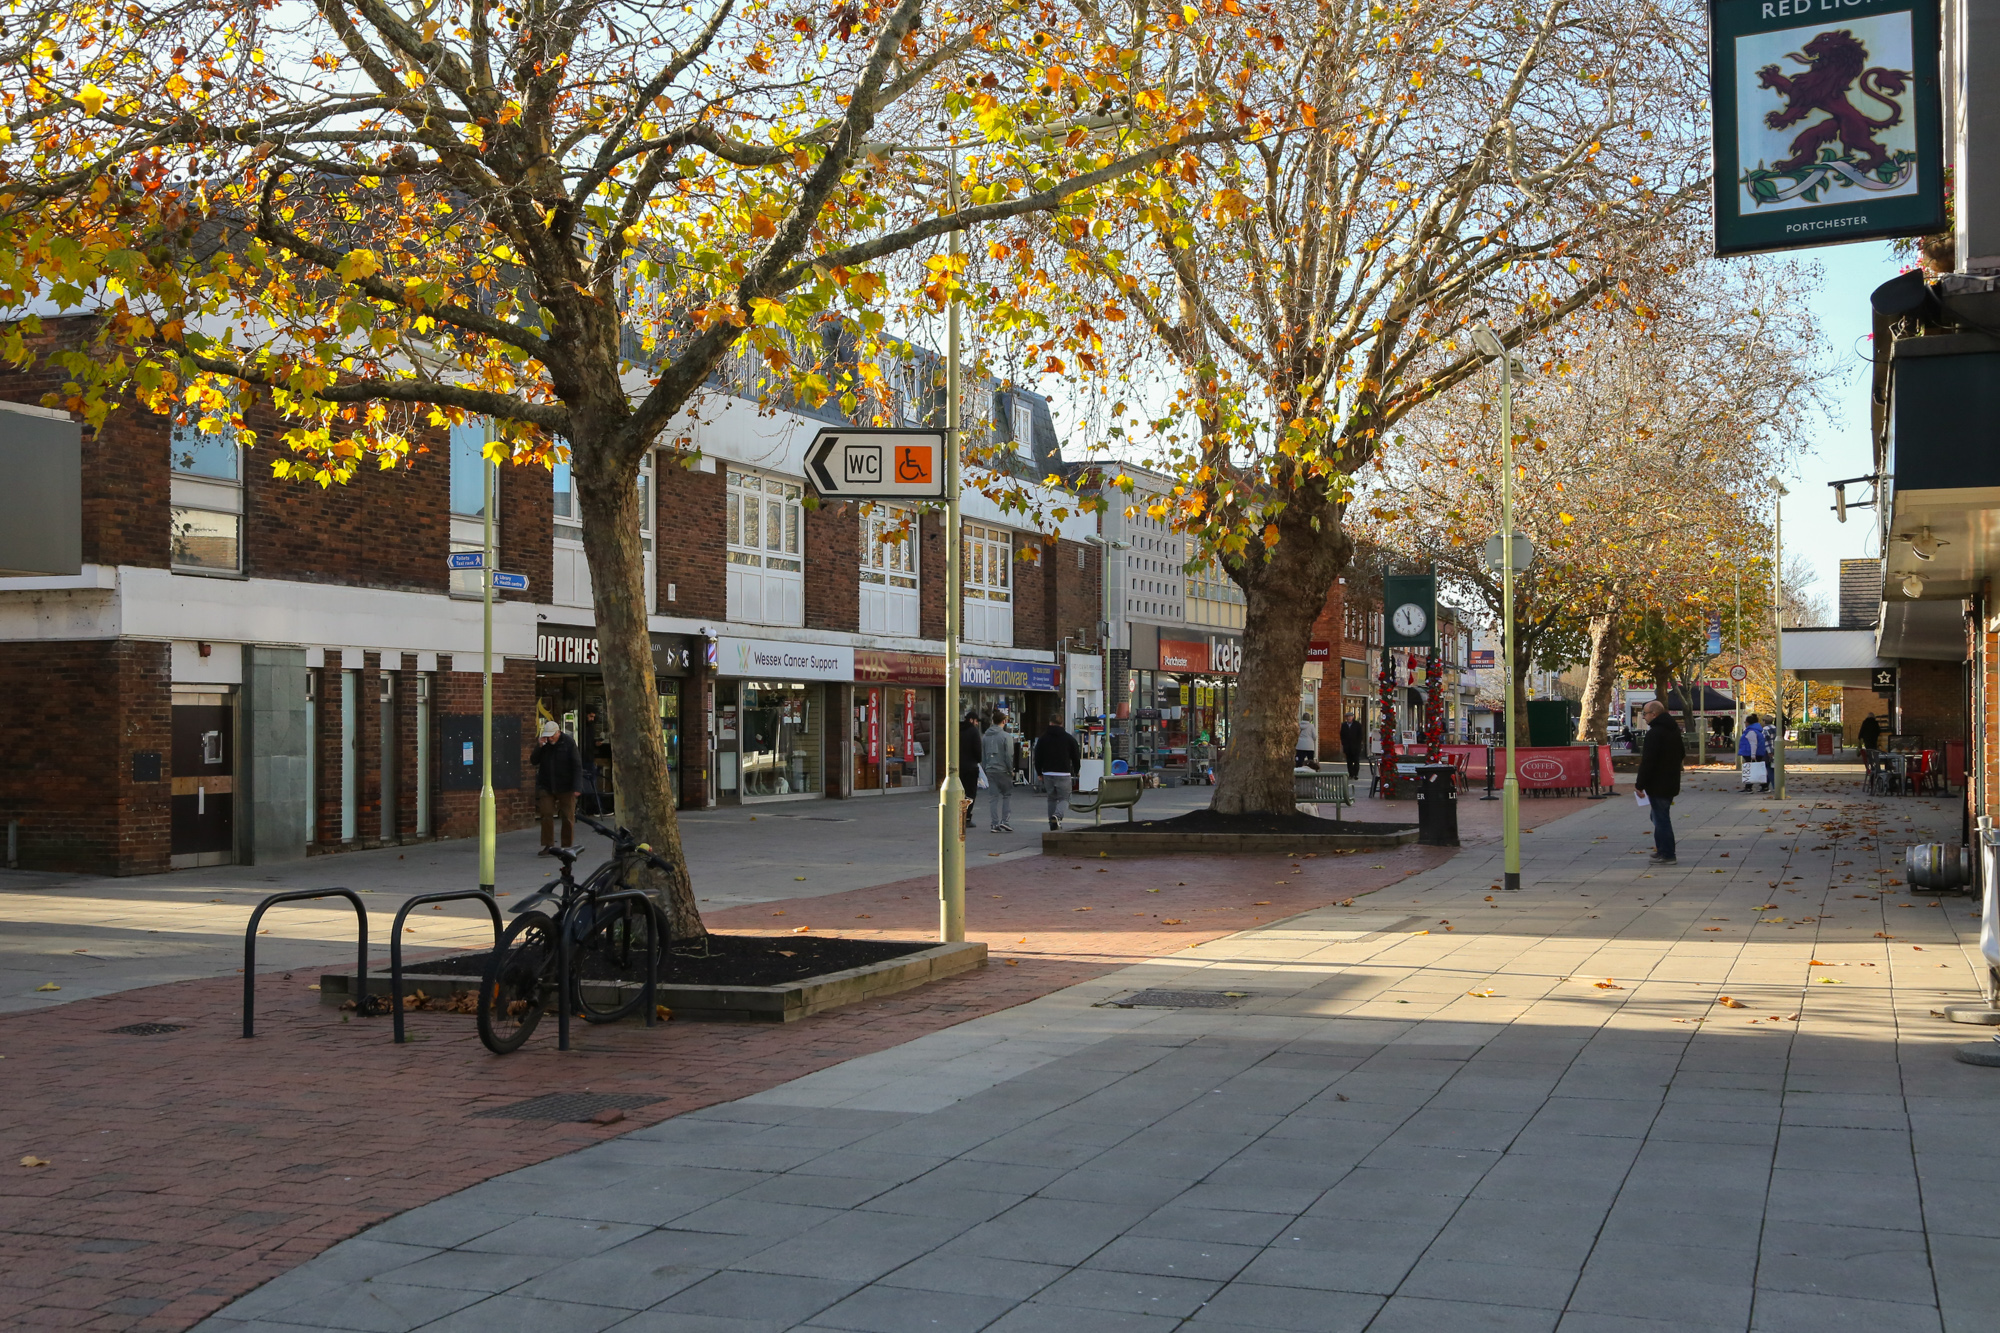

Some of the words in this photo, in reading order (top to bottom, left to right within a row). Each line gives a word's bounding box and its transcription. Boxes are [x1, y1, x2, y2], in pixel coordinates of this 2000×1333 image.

[1762, 0, 1811, 19] RED
[1786, 216, 1868, 233] PORTCHESTER
[849, 455, 877, 474] WC
[754, 652, 782, 667] Wessex
[784, 654, 808, 668] Cancer
[811, 656, 838, 671] Support
[861, 652, 889, 680] TBS
[897, 655, 925, 665] DISCOUNT
[1743, 763, 1751, 784] M&S
